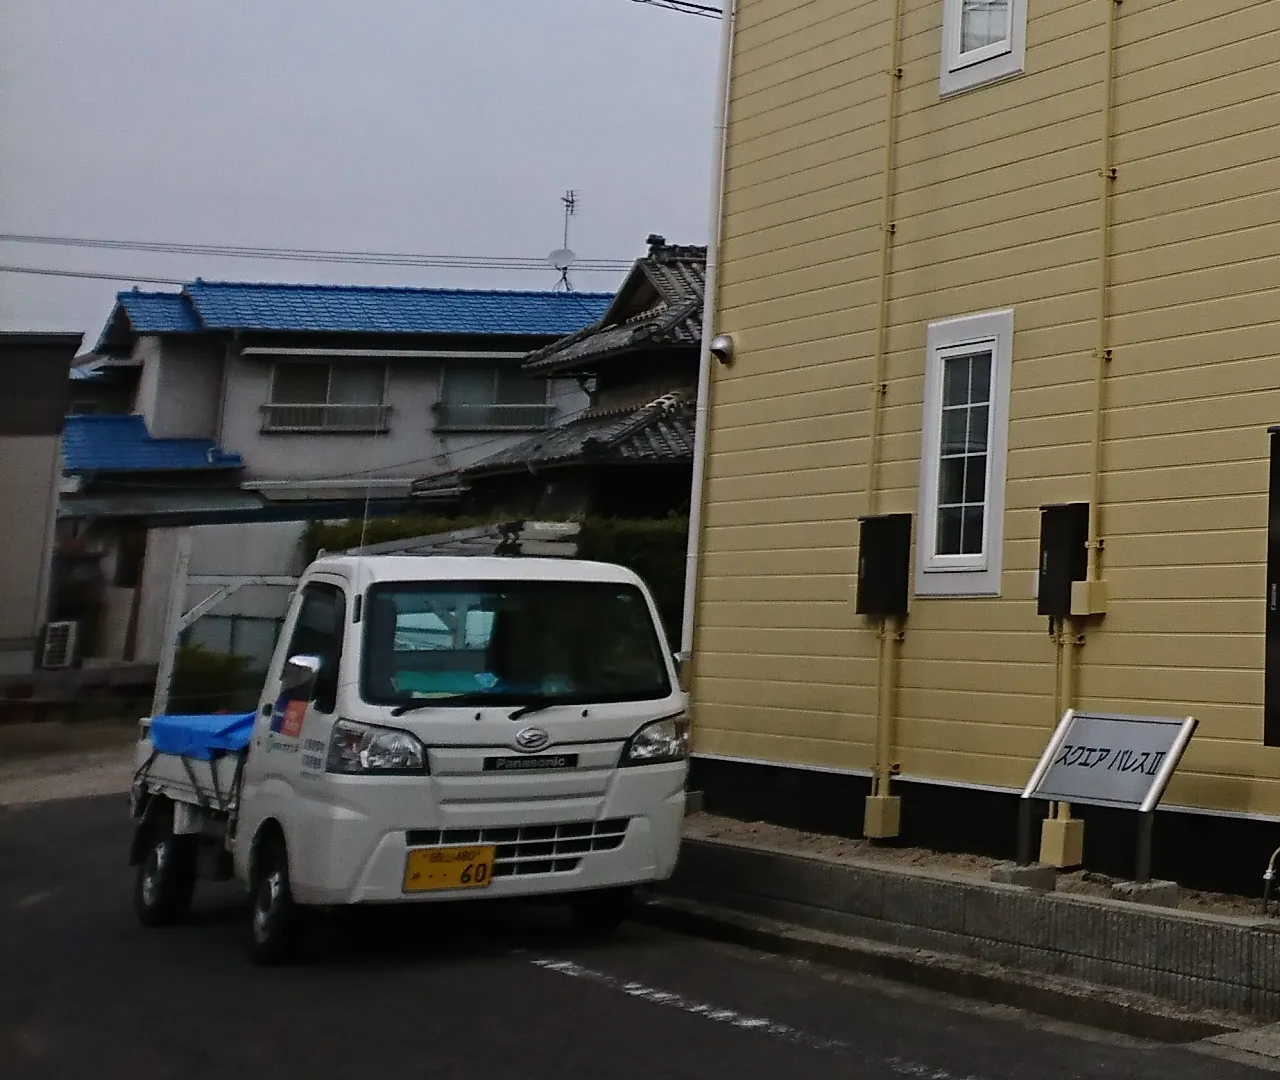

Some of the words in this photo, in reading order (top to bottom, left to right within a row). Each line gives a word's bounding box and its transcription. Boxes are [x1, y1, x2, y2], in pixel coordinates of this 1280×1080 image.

[496, 756, 565, 769] Panasonic
[1055, 745, 1111, 768] スクエア
